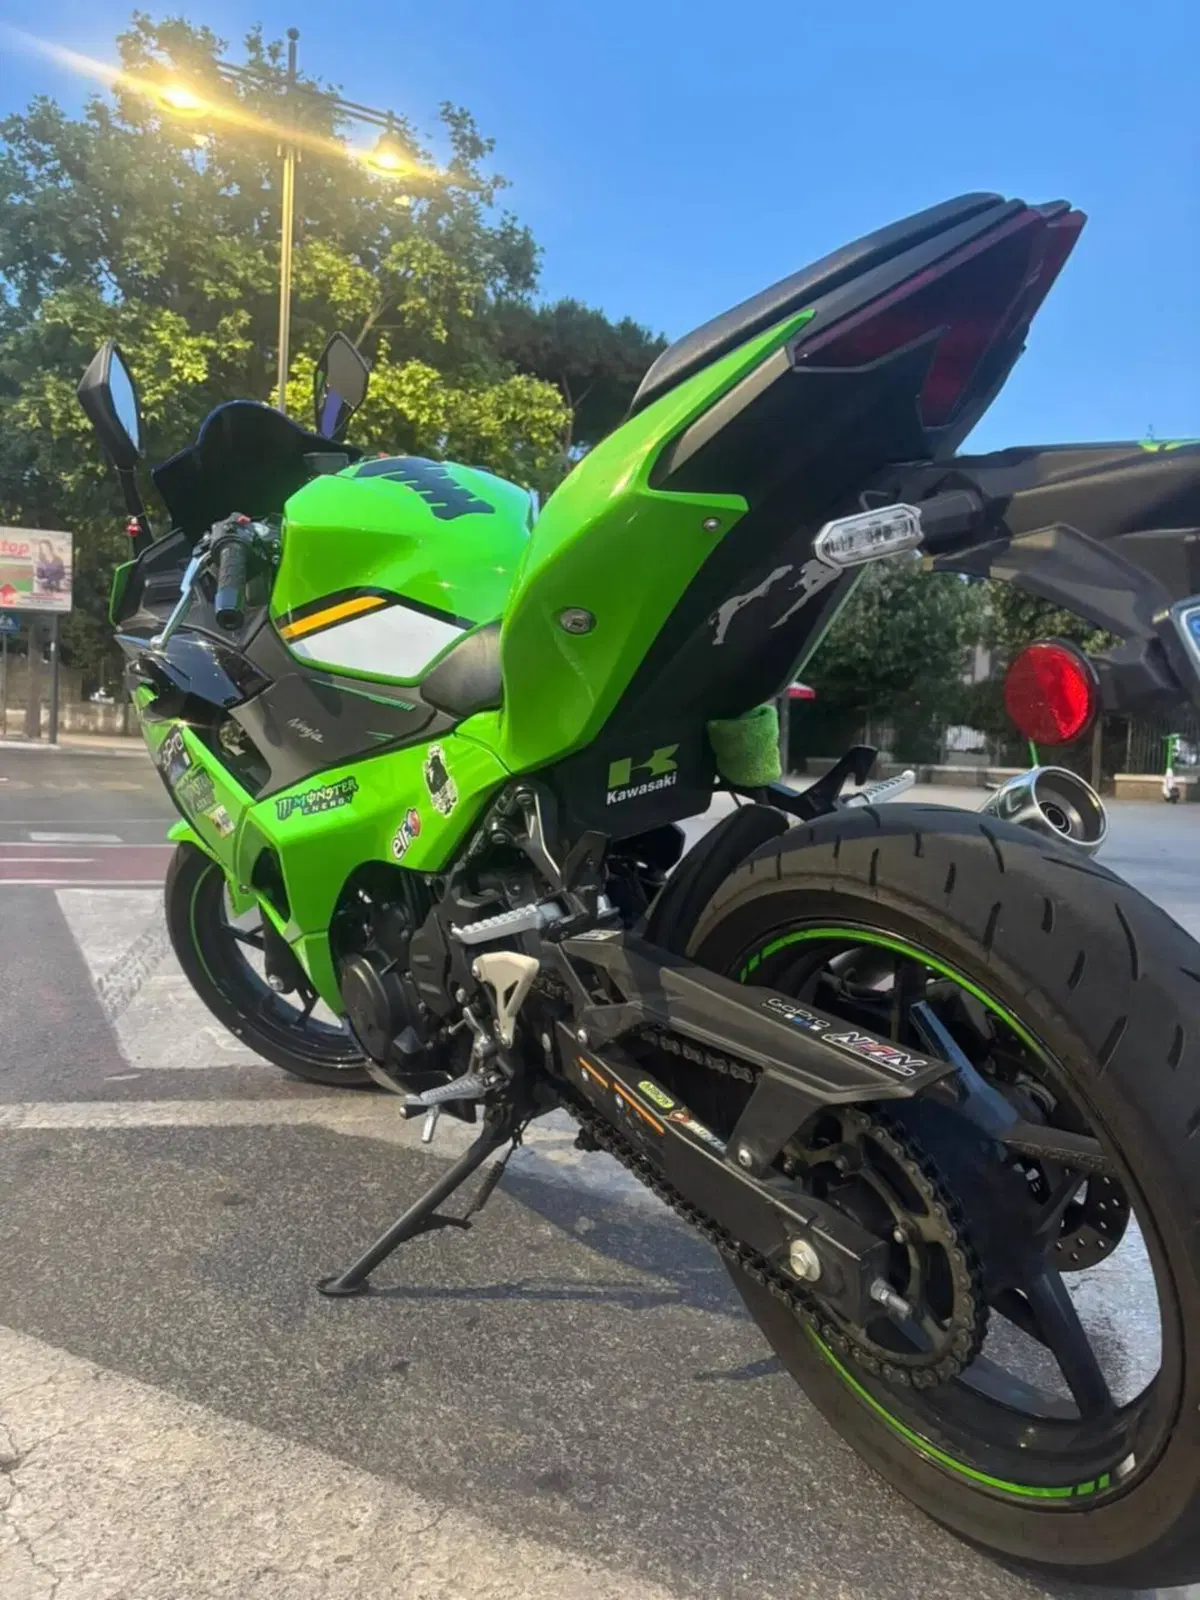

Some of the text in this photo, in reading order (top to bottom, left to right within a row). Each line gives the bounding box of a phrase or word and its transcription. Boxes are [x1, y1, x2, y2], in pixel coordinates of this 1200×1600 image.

[294, 778, 358, 807] MONSTER
[606, 771, 677, 805] Kawasaki
[766, 997, 832, 1028] GoPro
